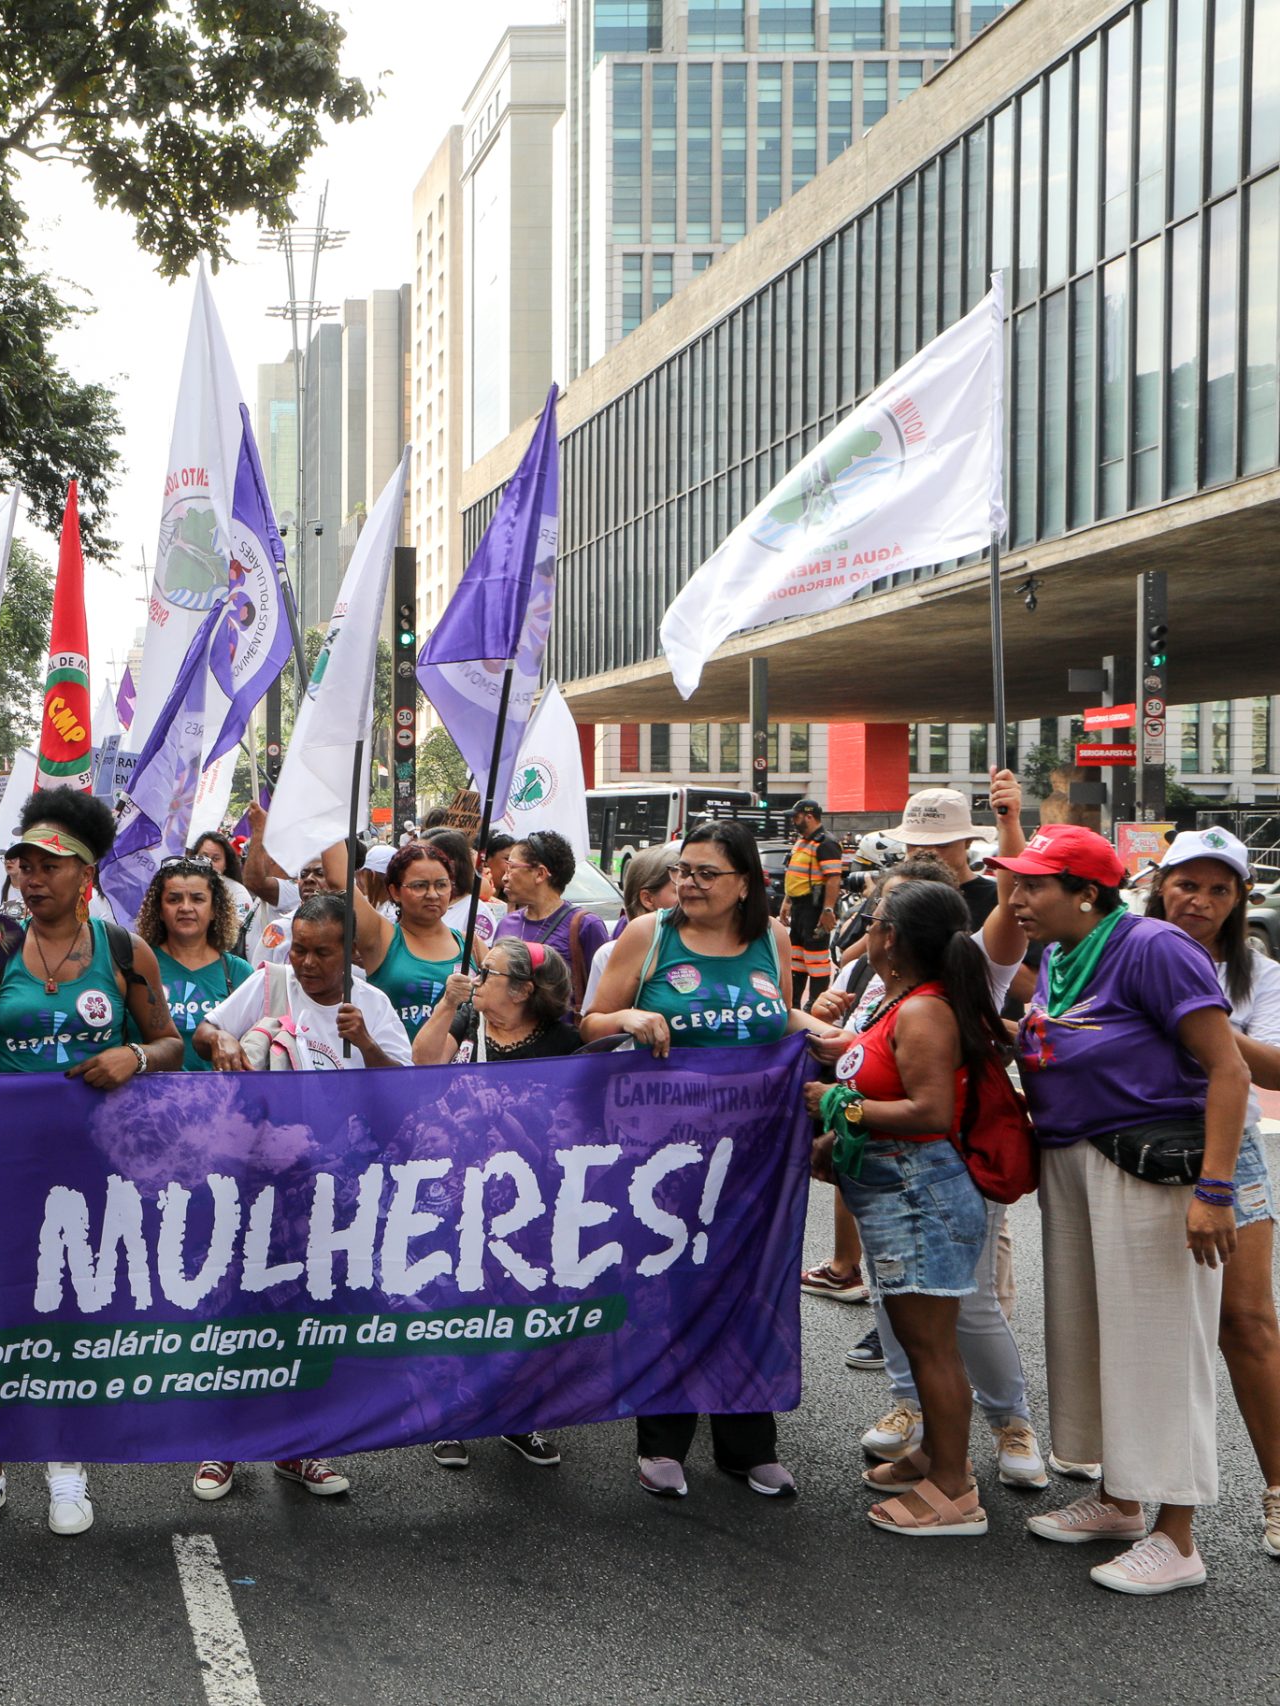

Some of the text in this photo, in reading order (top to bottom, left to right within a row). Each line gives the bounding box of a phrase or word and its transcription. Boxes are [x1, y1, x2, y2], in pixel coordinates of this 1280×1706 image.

[48, 697, 86, 743] CMP
[399, 712, 412, 721] 50
[1148, 702, 1161, 711] 50
[33, 1137, 734, 1313] MULHERES!
[73, 1328, 182, 1359] salário
[191, 1324, 286, 1356] digno,
[298, 1317, 347, 1346] fim
[357, 1316, 397, 1343] da
[407, 1309, 514, 1341] escala
[525, 1306, 580, 1338] 6x1
[584, 1308, 603, 1328] e
[106, 1378, 125, 1399] e
[133, 1374, 153, 1395] o
[161, 1359, 302, 1393] racismo!
